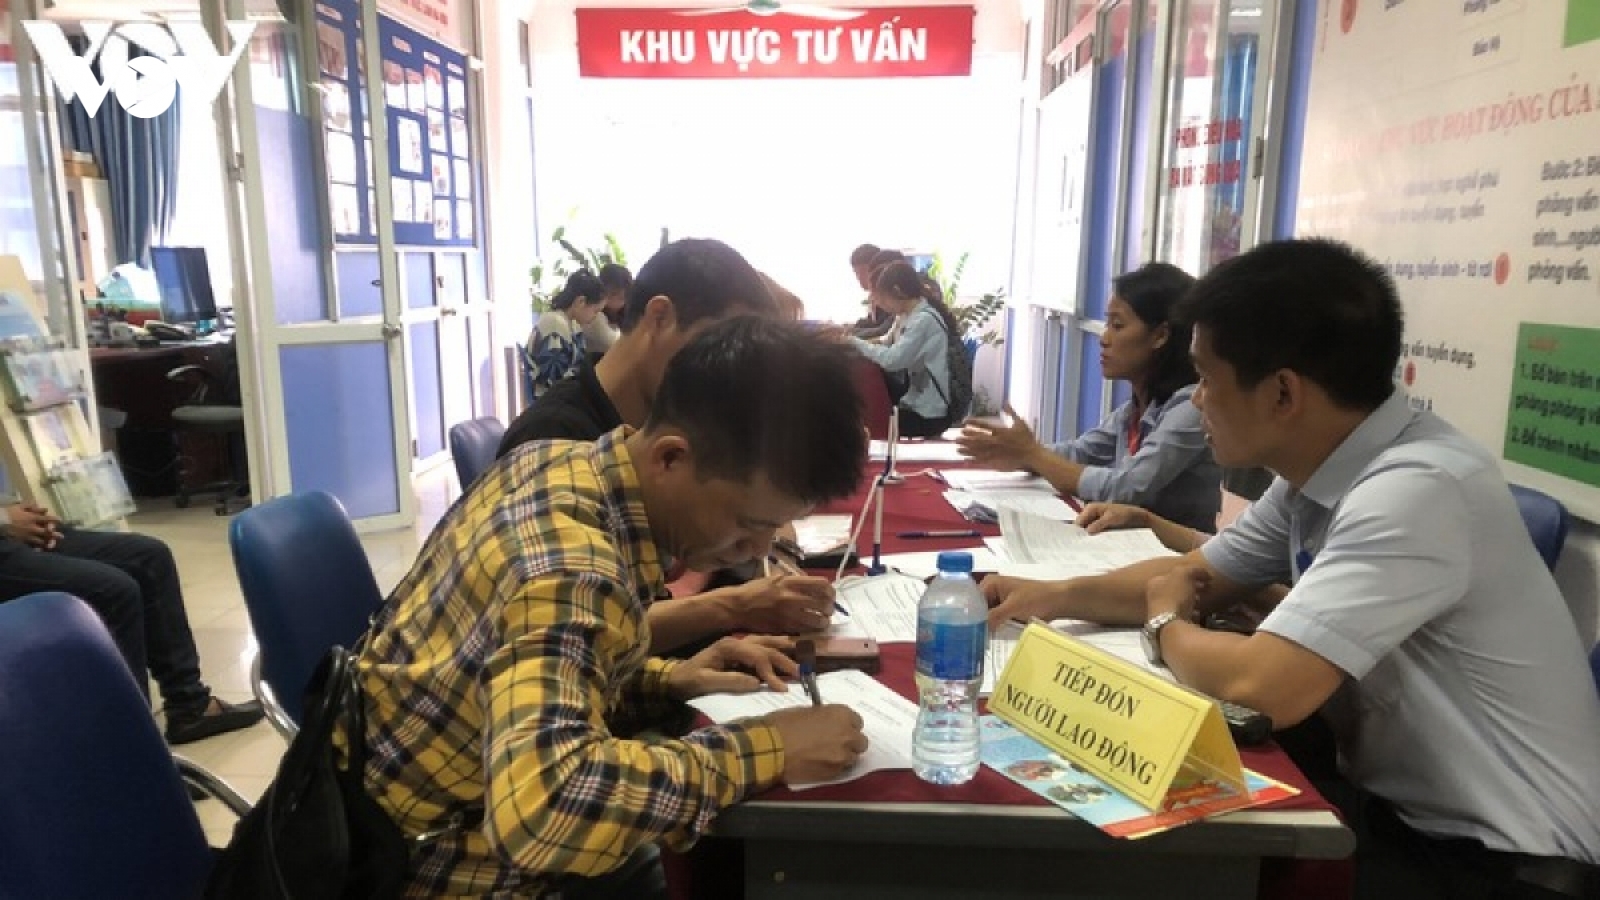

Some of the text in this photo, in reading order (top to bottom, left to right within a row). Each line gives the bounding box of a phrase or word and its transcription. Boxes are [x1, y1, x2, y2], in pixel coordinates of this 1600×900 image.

[620, 16, 928, 72] KHU VỰC TƯ VẤN
[1548, 72, 1593, 120] CỦA
[1052, 660, 1141, 720] TIẾP ĐÓN
[1001, 683, 1158, 786] NGƯỜI LAO ĐỘNG
